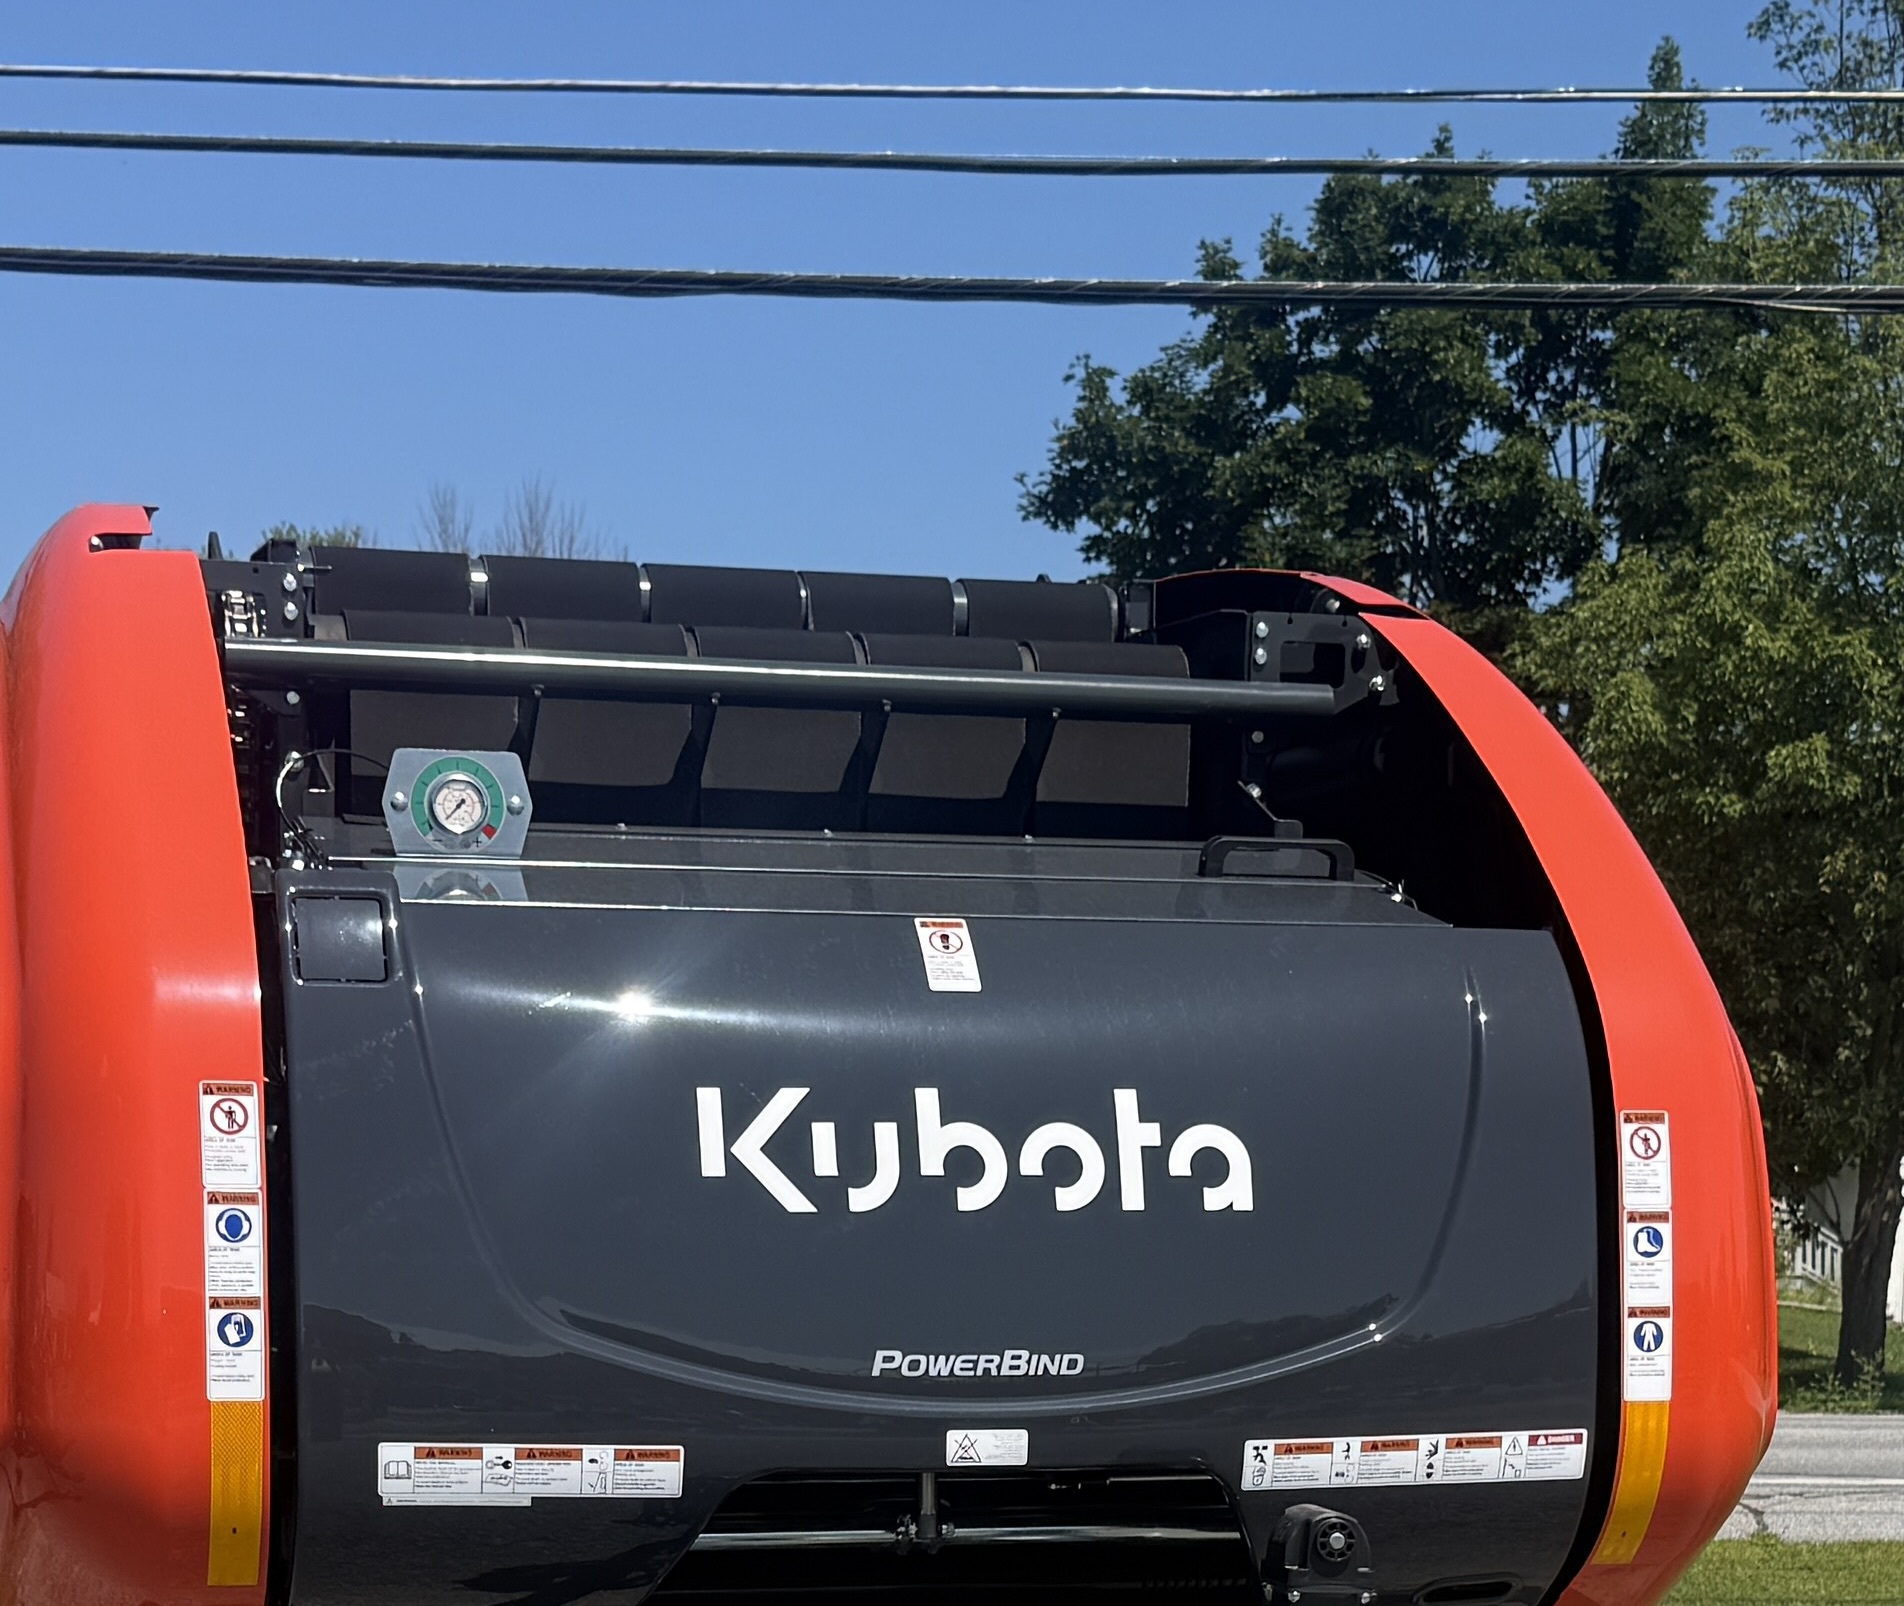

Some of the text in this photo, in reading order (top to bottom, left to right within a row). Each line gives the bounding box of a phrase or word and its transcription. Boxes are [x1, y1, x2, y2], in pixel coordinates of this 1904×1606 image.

[216, 1086, 252, 1094] WARNING
[696, 1086, 1255, 1213] Kubota
[539, 1451, 573, 1459] WARNING
